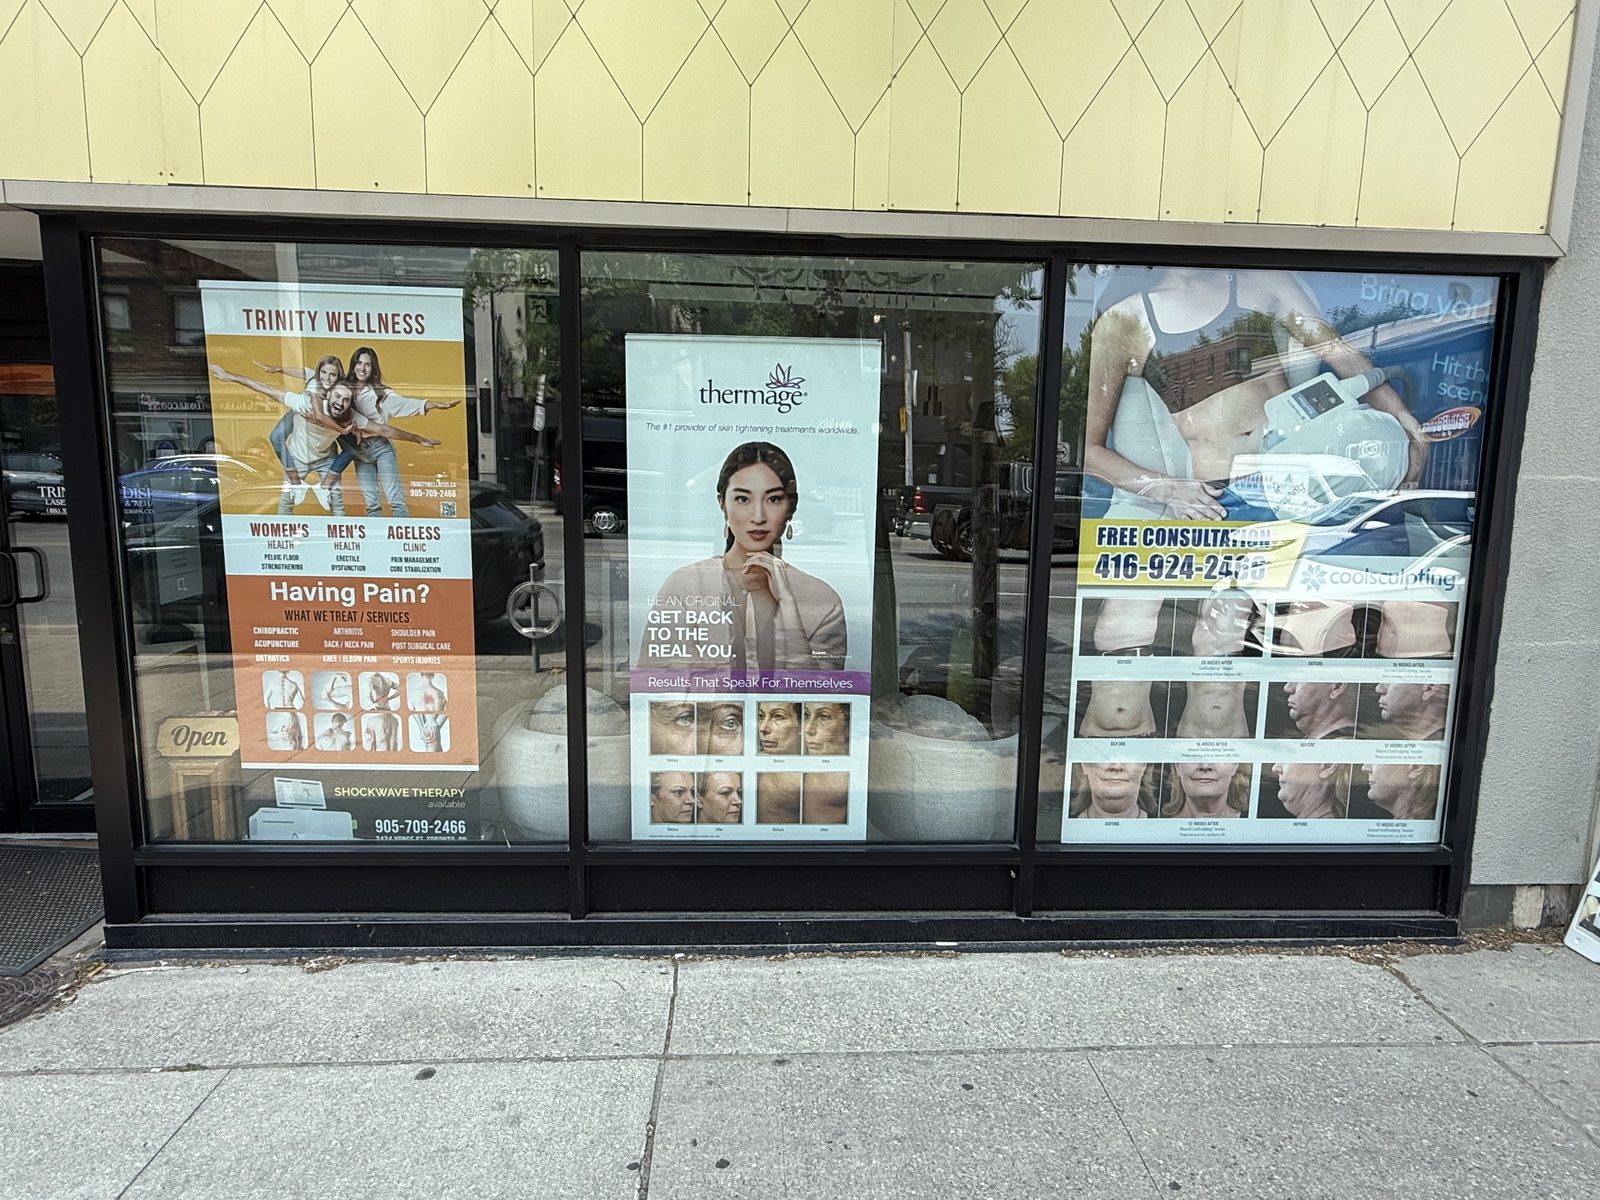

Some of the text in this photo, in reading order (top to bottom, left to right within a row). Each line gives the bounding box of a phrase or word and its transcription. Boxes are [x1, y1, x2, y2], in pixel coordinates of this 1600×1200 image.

[1361, 275, 1429, 311] Bring
[243, 309, 425, 334] TRINITY WELLNESS
[1432, 352, 1461, 377] Hit
[699, 379, 803, 414] thermage
[646, 423, 661, 431] The
[663, 423, 672, 431] #1
[674, 423, 706, 433] provider
[708, 424, 717, 432] of
[718, 424, 734, 432] skin
[735, 424, 773, 434] tightening
[775, 425, 816, 434] treatments
[250, 522, 310, 538] WOMEN'S
[327, 524, 366, 540] MEN'S
[387, 525, 441, 541] AGELESS
[1097, 527, 1272, 549] FREE CONSULTATION
[267, 540, 295, 550] HEALTH
[334, 541, 361, 551] HEALTH
[403, 542, 427, 552] CLINIC
[264, 553, 282, 561] PELVIC
[336, 554, 360, 563] ERECTILE
[404, 556, 440, 564] MANAGEMENT
[261, 563, 304, 571] STRENGTHENING
[331, 564, 367, 572] DYSFUNCTION
[390, 565, 404, 573] CORE
[1330, 567, 1456, 591] coolsculpting
[270, 581, 430, 608] Having Pain?
[665, 595, 683, 606] AN
[284, 609, 311, 622] WHAT
[313, 610, 329, 622] WE
[330, 610, 358, 623] TREAT
[366, 611, 410, 624] SERVICES
[647, 610, 734, 625] GET BACK
[253, 626, 300, 635] CHIROPRACTIC
[333, 627, 364, 636] ARTHRITIS
[390, 628, 436, 638] SHOULDER PAIN
[647, 627, 709, 641] TO THE
[254, 639, 300, 648] ACUPUNCTURE
[323, 640, 340, 648] BACK
[344, 640, 361, 649] NECK
[360, 641, 375, 649] PAIN
[391, 641, 452, 651] POST SURGICAL CARE
[648, 644, 737, 658] REAL YOU.
[255, 654, 290, 663] ORTHOTICS
[322, 654, 338, 663] KNEE
[343, 654, 363, 663] ELBOW
[363, 655, 378, 663] PAIN
[392, 656, 441, 665] SPORTS INJURIES
[648, 677, 853, 692] Results That Speak For Themselves
[171, 724, 228, 753] Open
[334, 786, 466, 799] SHOCKWAVE THERAPY
[427, 800, 466, 809] available
[375, 819, 466, 834] 905-709-2466
